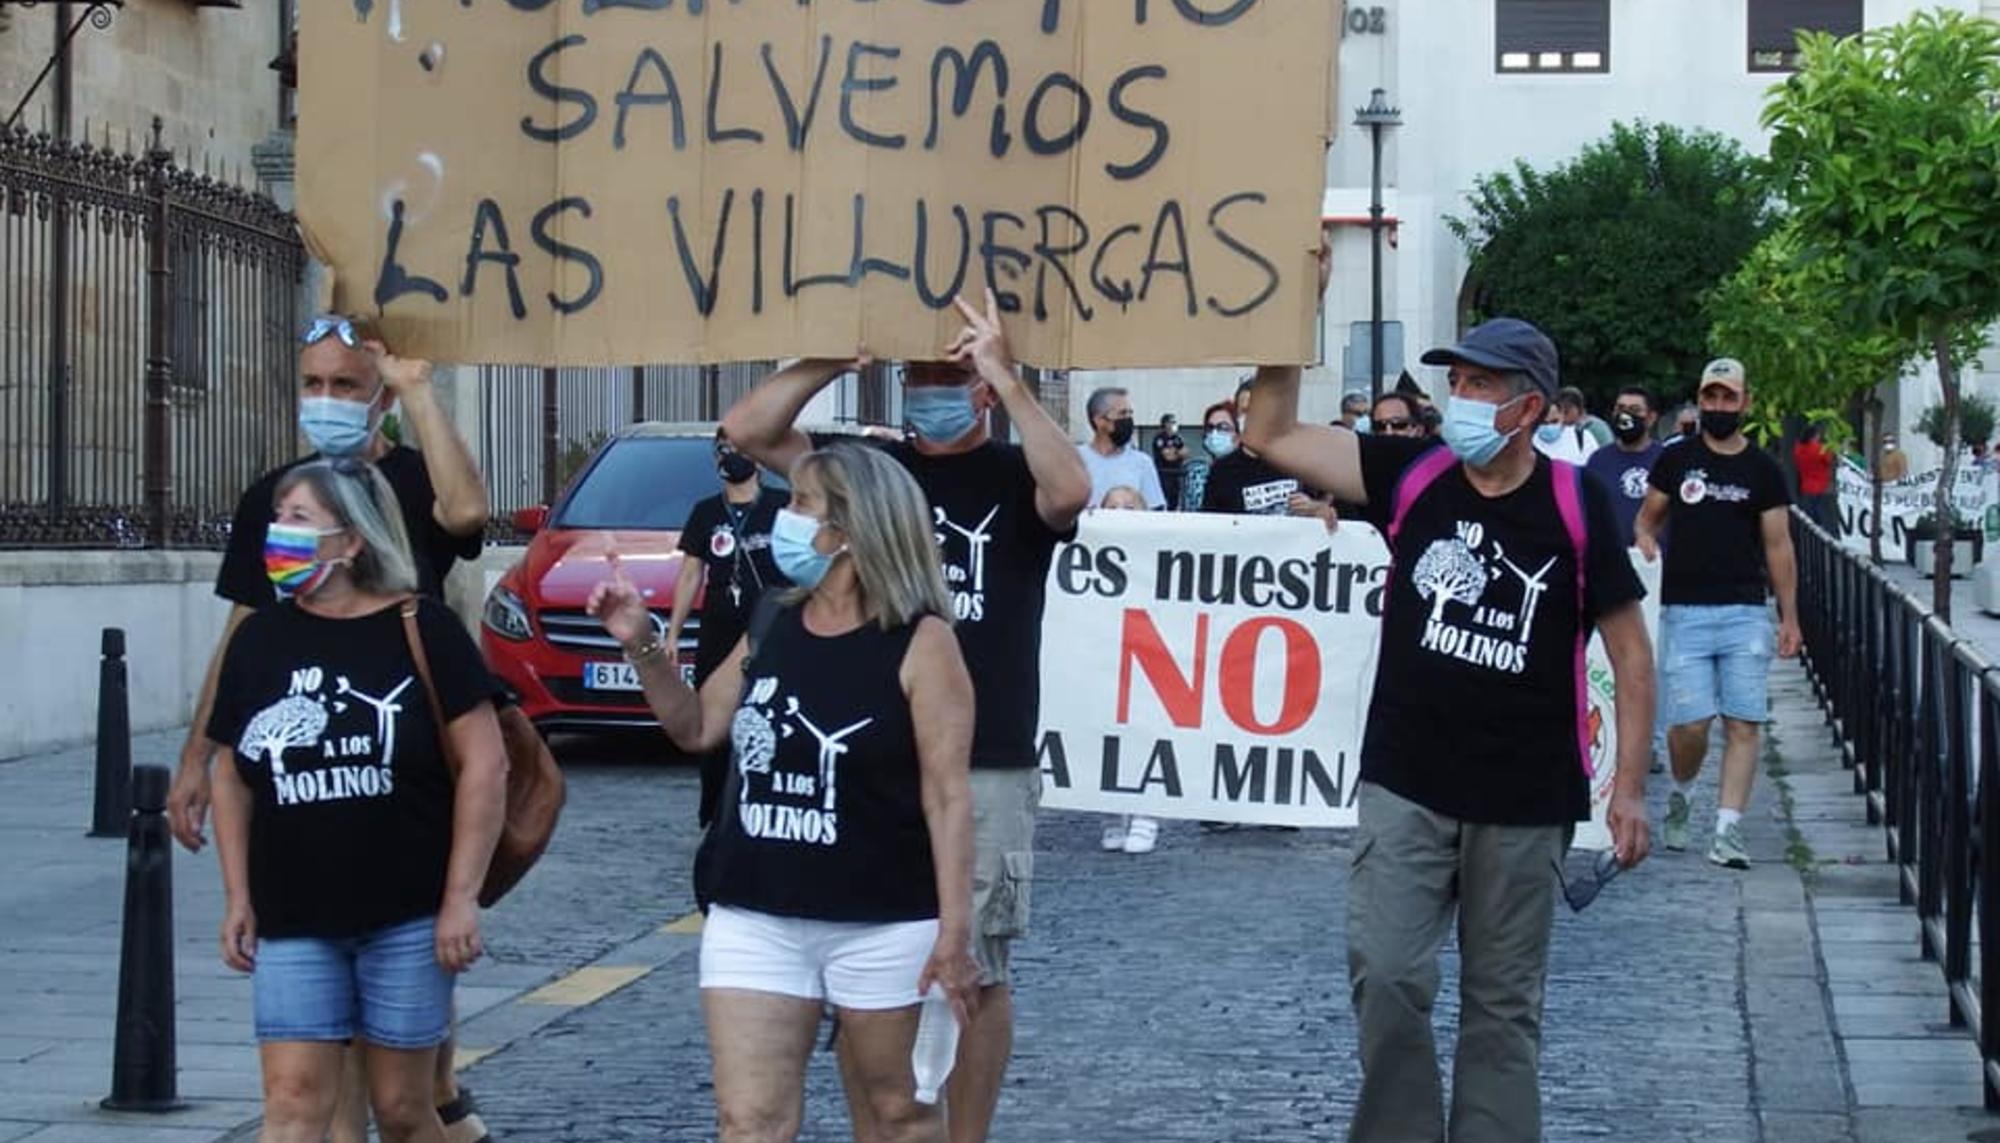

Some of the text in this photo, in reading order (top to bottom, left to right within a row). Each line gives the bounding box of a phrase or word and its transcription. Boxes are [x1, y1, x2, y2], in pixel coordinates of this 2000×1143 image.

[520, 34, 1170, 180] SALVEMOS
[375, 197, 605, 320] LAS
[1456, 519, 1485, 550] NO
[1056, 542, 1388, 617] es nuestra
[1473, 606, 1516, 631] A LOS
[1116, 607, 1322, 735] NO
[1420, 620, 1528, 674] MOLINOS
[288, 666, 323, 695] NO
[323, 735, 371, 758] A LOS
[1036, 730, 1071, 788] A
[1100, 735, 1183, 797] LA
[273, 764, 393, 806] MOLINOS
[772, 771, 815, 796] A LOS
